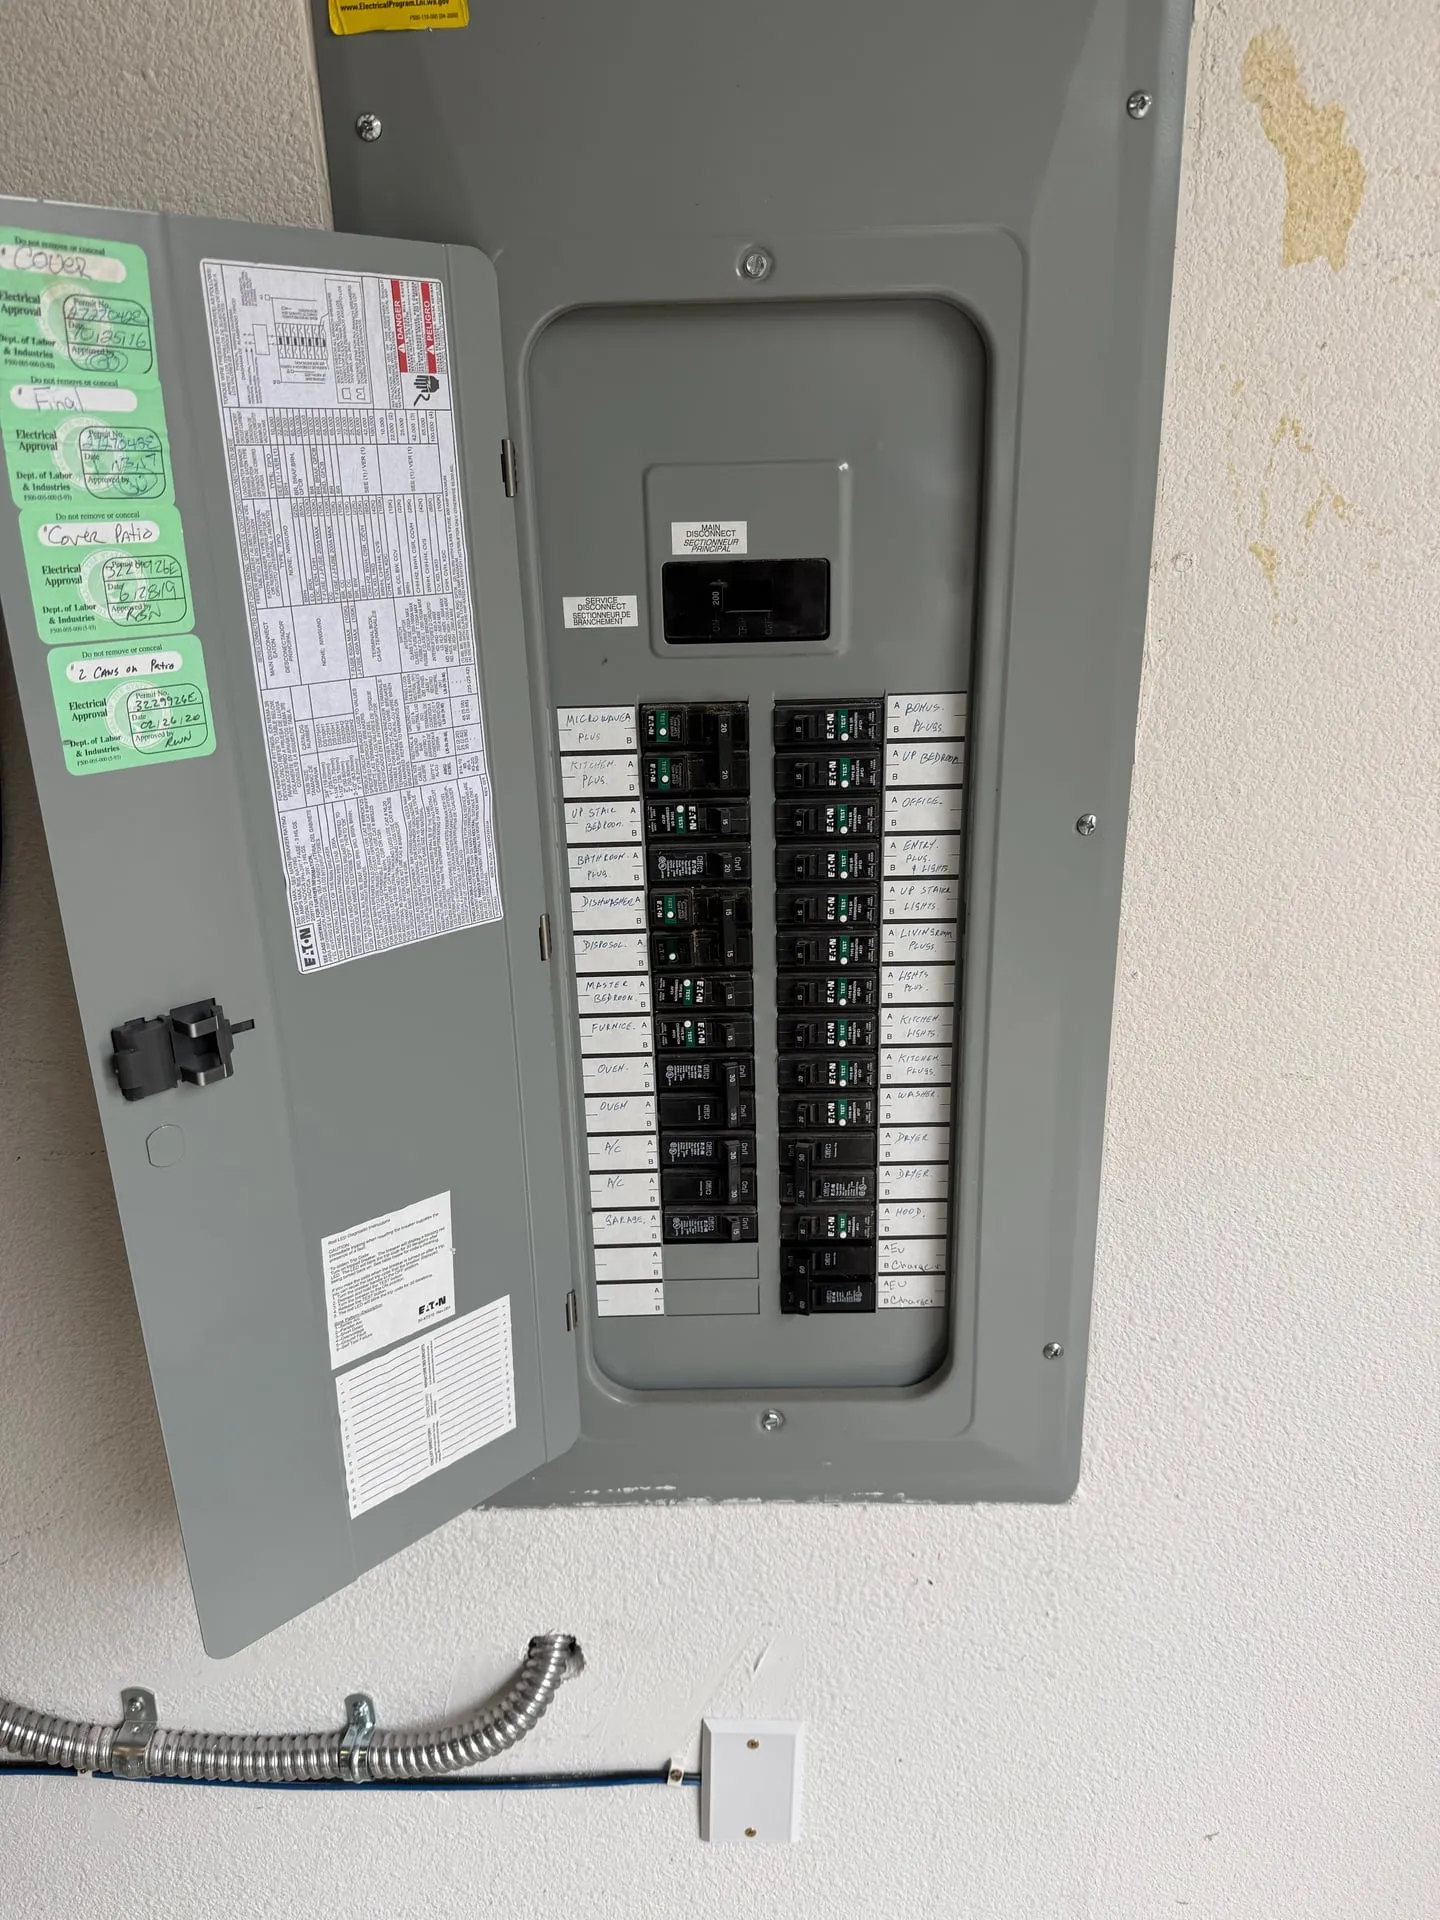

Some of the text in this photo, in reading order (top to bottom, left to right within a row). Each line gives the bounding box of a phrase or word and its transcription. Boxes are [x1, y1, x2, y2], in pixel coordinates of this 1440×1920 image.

[14, 236, 27, 245] Do
[28, 239, 40, 247] not
[41, 240, 69, 251] remove
[79, 247, 105, 256] conceal
[1, 304, 42, 317] Approval
[394, 299, 405, 341] DANGER
[423, 299, 434, 342] PELIGRO
[32, 336, 57, 347] Labor
[3, 347, 54, 359] & Industries
[30, 376, 42, 385] Do
[57, 379, 83, 387] remove
[93, 380, 118, 388] conceal
[33, 386, 85, 413] Final
[16, 429, 57, 440] Electrical
[19, 440, 58, 453] Approval
[84, 453, 99, 461] Date
[17, 472, 38, 481] Dept.
[50, 472, 72, 480] Labor
[88, 477, 118, 486] Approved
[23, 483, 71, 492] & Industries
[55, 513, 67, 521] Do
[80, 512, 104, 520] remove
[115, 511, 140, 519] conceal
[686, 529, 736, 538] DISCONNECT
[683, 538, 740, 547] SECTIONNEUR
[690, 545, 731, 553] PRINCIPAL
[42, 564, 82, 575] Electrical
[44, 576, 83, 588] Approval
[712, 591, 720, 606] 200
[42, 604, 97, 615] Dept. of Labor
[577, 603, 627, 611] DISCONNECT
[48, 614, 95, 624] & Industries
[572, 611, 620, 619] SECTIONNEUR
[573, 618, 623, 626] BRANCHEMENT
[82, 651, 93, 659] Do
[93, 651, 104, 659] not
[105, 649, 130, 657] remove
[139, 644, 163, 652] conceal
[78, 669, 87, 680] 2
[126, 665, 138, 673] on
[135, 690, 170, 700] Permit No.
[68, 698, 107, 710] Electrical
[72, 709, 108, 722] Approval
[721, 723, 728, 733] 20
[893, 725, 900, 733] B
[70, 739, 90, 748] Dept.
[100, 735, 121, 743] Labor
[135, 732, 165, 742] Approved
[626, 736, 632, 744] B
[75, 745, 120, 757] & Industries
[902, 750, 917, 762] UP
[722, 770, 728, 780] 20
[571, 807, 583, 818] UP
[900, 886, 915, 896] UP
[586, 980, 629, 991] MASTER
[729, 1074, 736, 1083] 30
[600, 1100, 628, 1111] OVEN
[894, 1131, 929, 1144] DRYER
[604, 1138, 622, 1155] A/C
[606, 1175, 625, 1188] A/C
